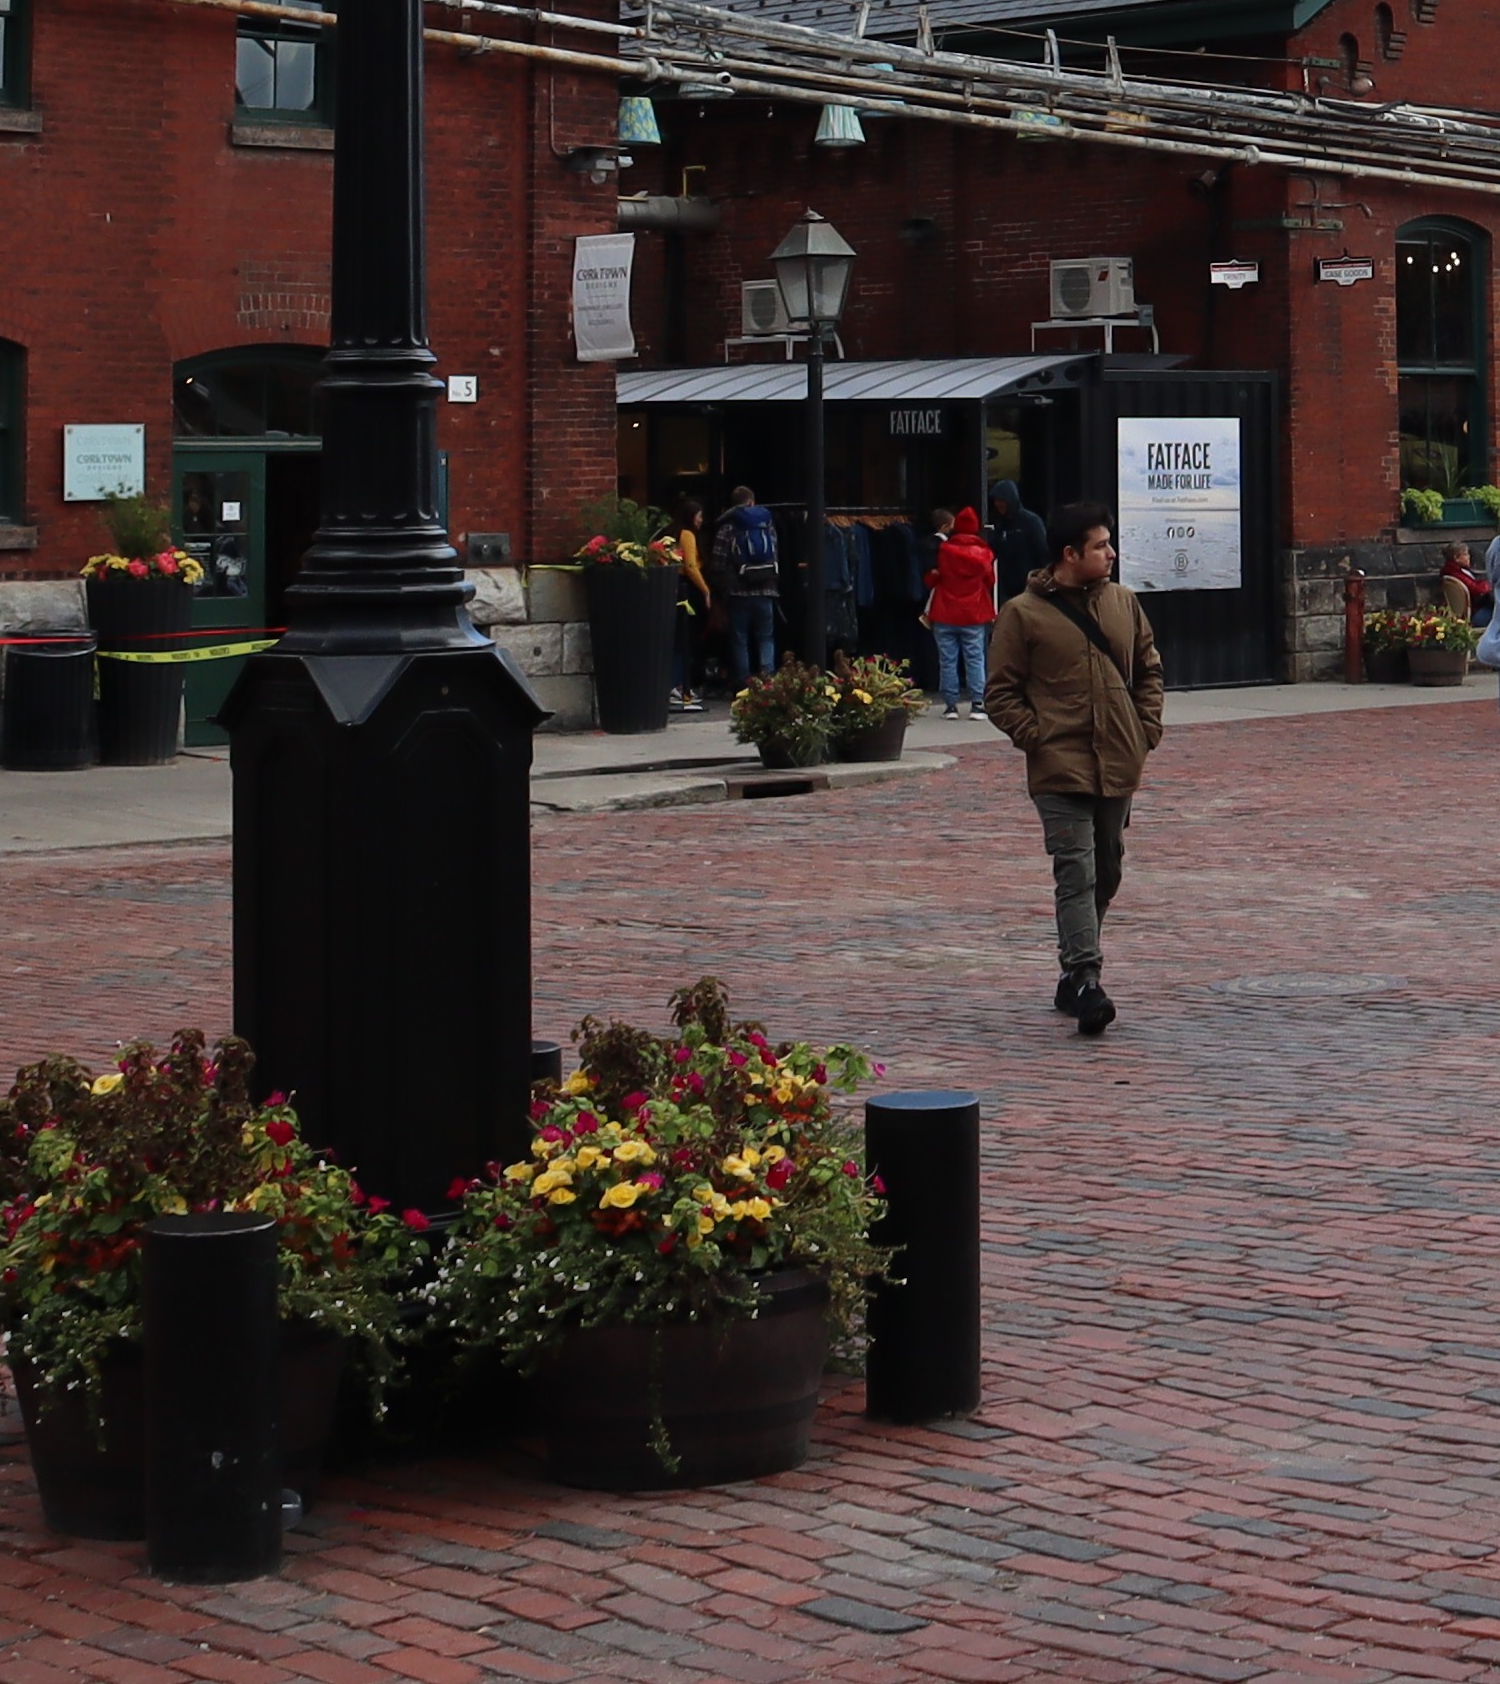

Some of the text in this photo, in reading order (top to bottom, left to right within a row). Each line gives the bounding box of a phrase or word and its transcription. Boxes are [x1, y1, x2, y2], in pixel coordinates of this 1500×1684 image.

[576, 266, 628, 282] CORKTOWN
[1325, 268, 1369, 279] CASE GOODS
[464, 380, 473, 397] 5
[890, 409, 942, 434] FATFACE
[76, 453, 133, 465] CORKTOWN
[1148, 442, 1211, 470] FATFACE
[1148, 474, 1211, 490] MADE FOR LIFE
